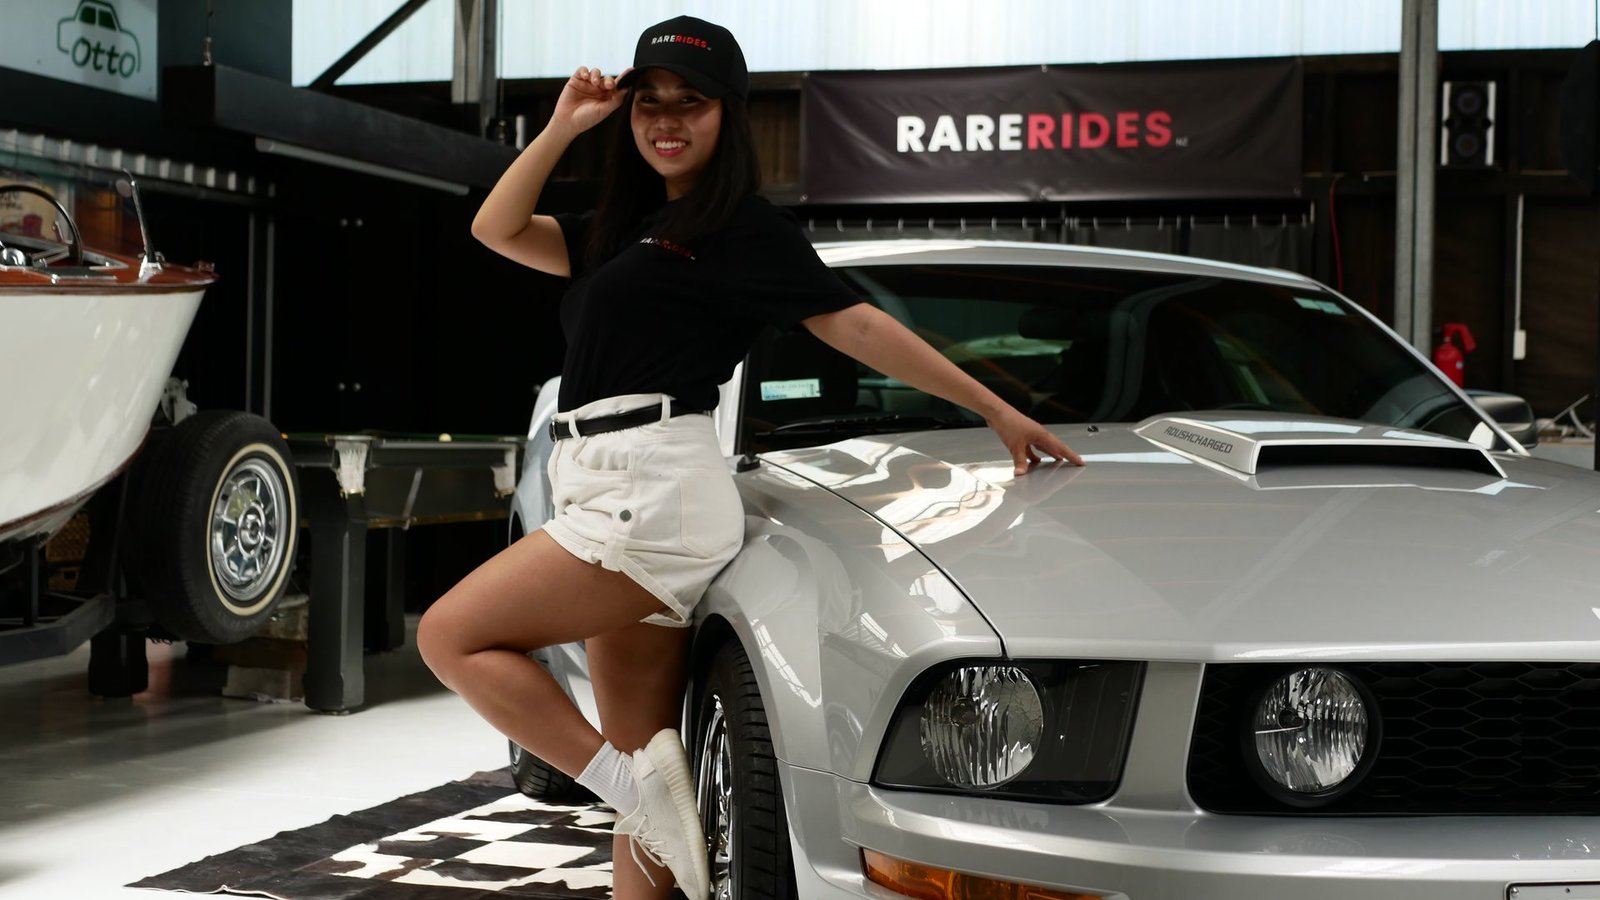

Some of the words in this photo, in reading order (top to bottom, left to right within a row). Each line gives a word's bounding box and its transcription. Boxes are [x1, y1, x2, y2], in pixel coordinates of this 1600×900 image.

[72, 37, 136, 78] Otto
[651, 34, 709, 49] RARERIDES
[896, 111, 1173, 153] RARERIDES
[1164, 426, 1234, 453] ROUSHCHARGED
